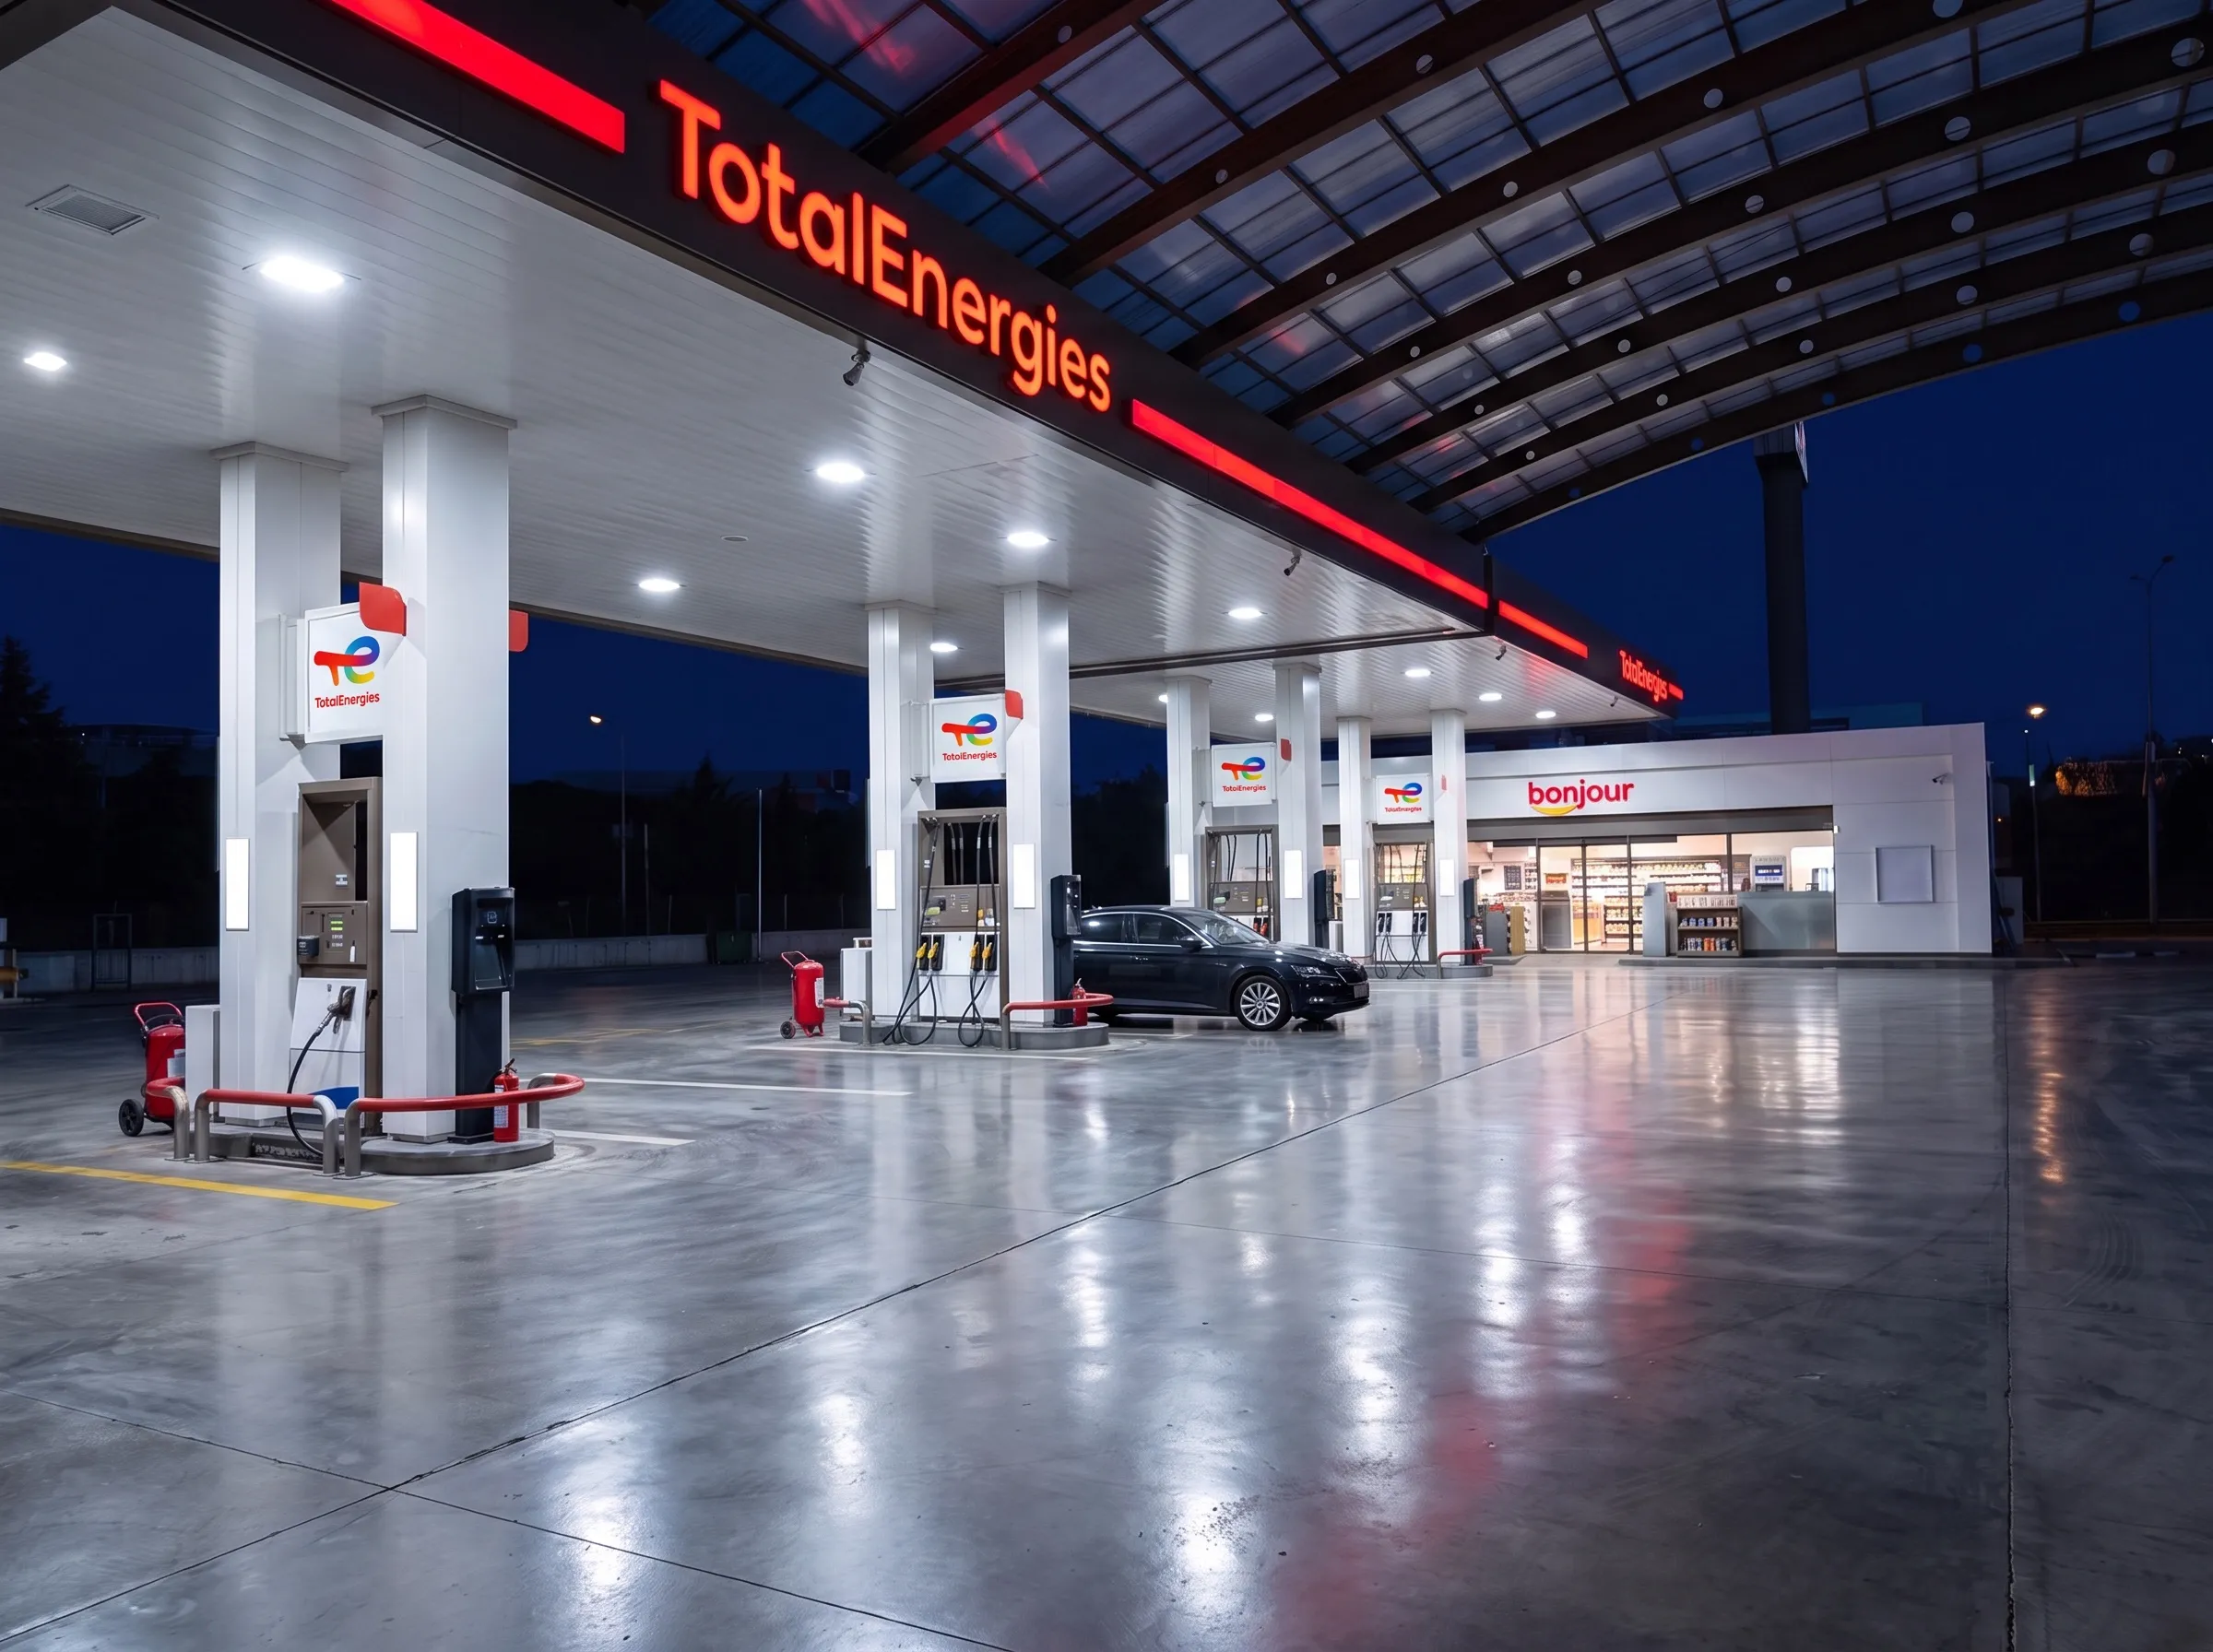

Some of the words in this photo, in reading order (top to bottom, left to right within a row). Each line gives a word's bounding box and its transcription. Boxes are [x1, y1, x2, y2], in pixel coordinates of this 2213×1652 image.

[658, 78, 1113, 414] TotalEnergies
[314, 691, 381, 709] TotalEnergies
[1528, 778, 1635, 810] bonjour
